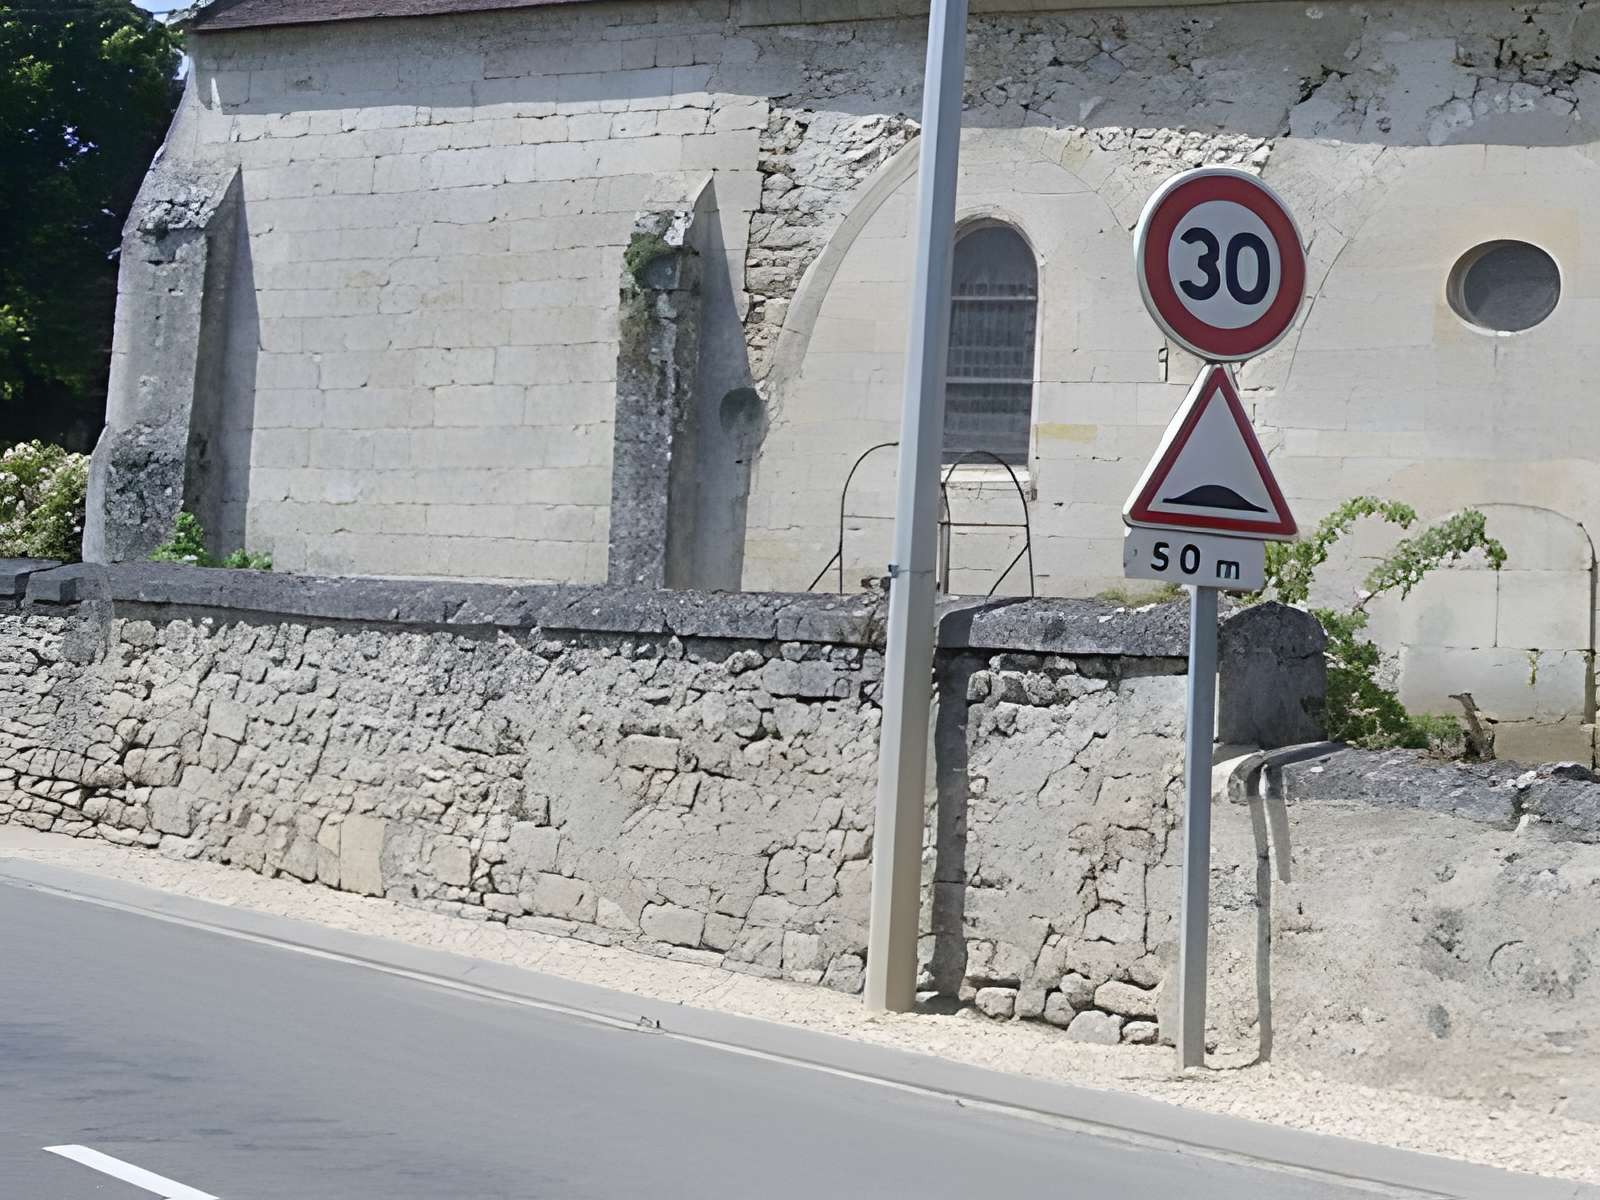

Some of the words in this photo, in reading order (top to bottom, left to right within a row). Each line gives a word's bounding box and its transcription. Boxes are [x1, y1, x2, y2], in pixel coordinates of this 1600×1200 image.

[1179, 227, 1271, 306] 30
[1150, 541, 1201, 575] 50
[1216, 559, 1240, 580] m
